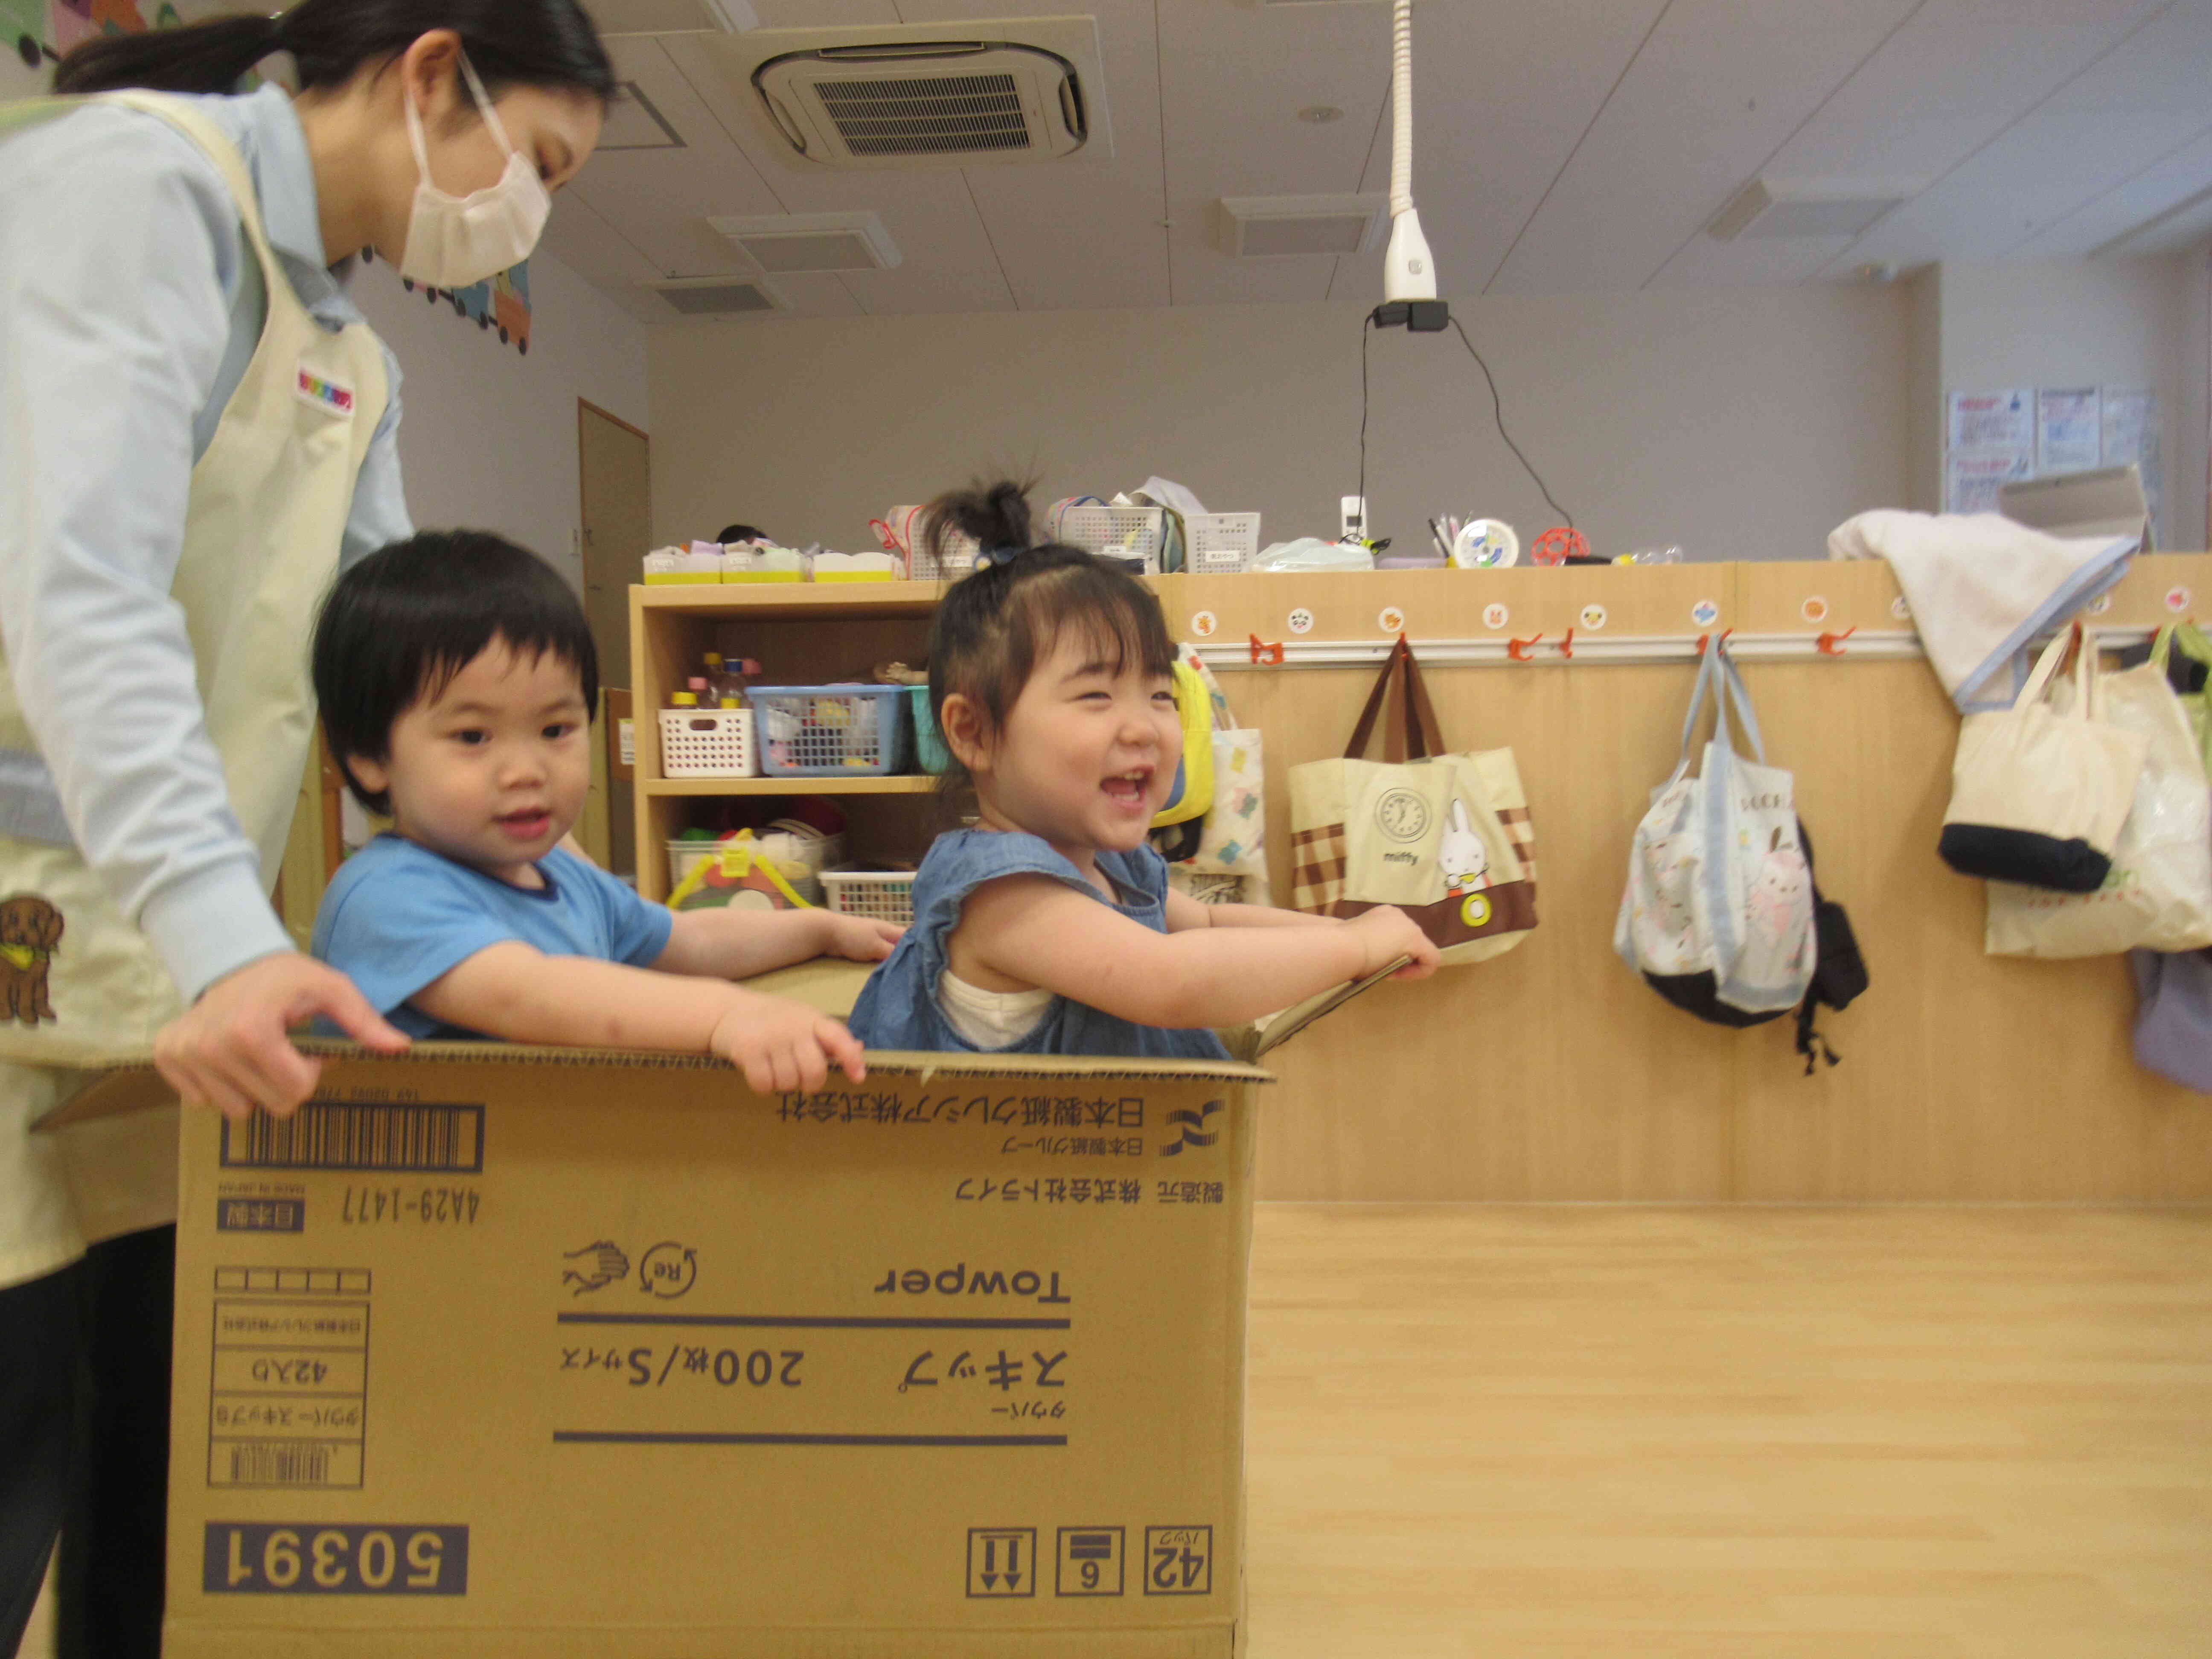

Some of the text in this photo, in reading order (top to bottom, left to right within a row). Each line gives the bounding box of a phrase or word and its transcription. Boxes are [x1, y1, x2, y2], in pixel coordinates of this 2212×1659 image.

[1384, 852, 1418, 866] miffy
[775, 1090, 1143, 1128] 日本製紙クレシア株式会社
[1000, 1135, 1142, 1156] 日本製紙グループ
[341, 1187, 480, 1224] 4A29-1477
[955, 1177, 1222, 1204] 製造元 株式会社トライフ
[224, 1200, 294, 1230] 日本製
[873, 1263, 1070, 1303] Towper
[251, 1358, 327, 1384] 42入り
[897, 1350, 1067, 1393] スキップ
[227, 1529, 444, 1587] 50391
[1080, 1560, 1100, 1589] 6
[1152, 1546, 1204, 1588] 42
